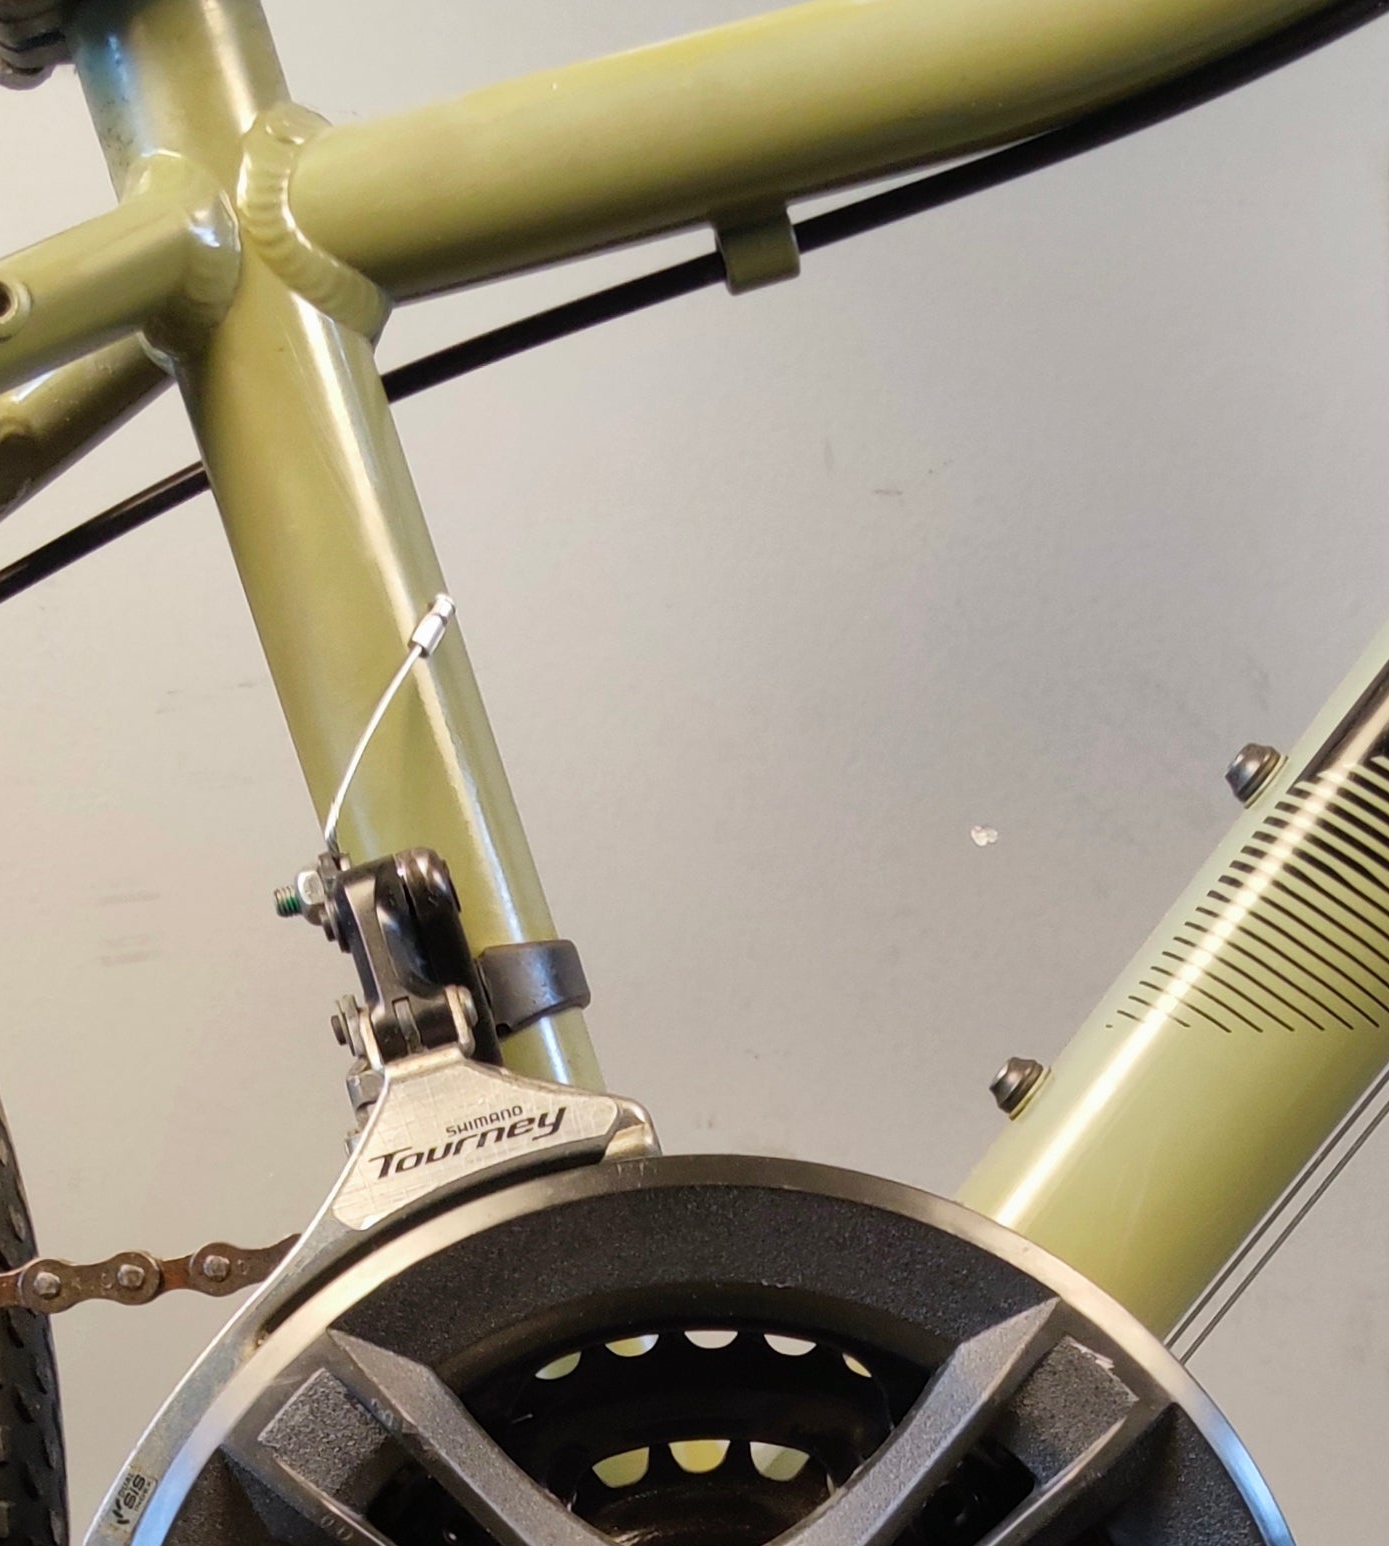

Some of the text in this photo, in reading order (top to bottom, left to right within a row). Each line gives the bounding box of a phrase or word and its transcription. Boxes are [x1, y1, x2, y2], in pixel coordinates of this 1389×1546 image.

[446, 1105, 523, 1136] SHIMANO
[368, 1106, 567, 1180] Tourney
[124, 1474, 146, 1509] SIS
